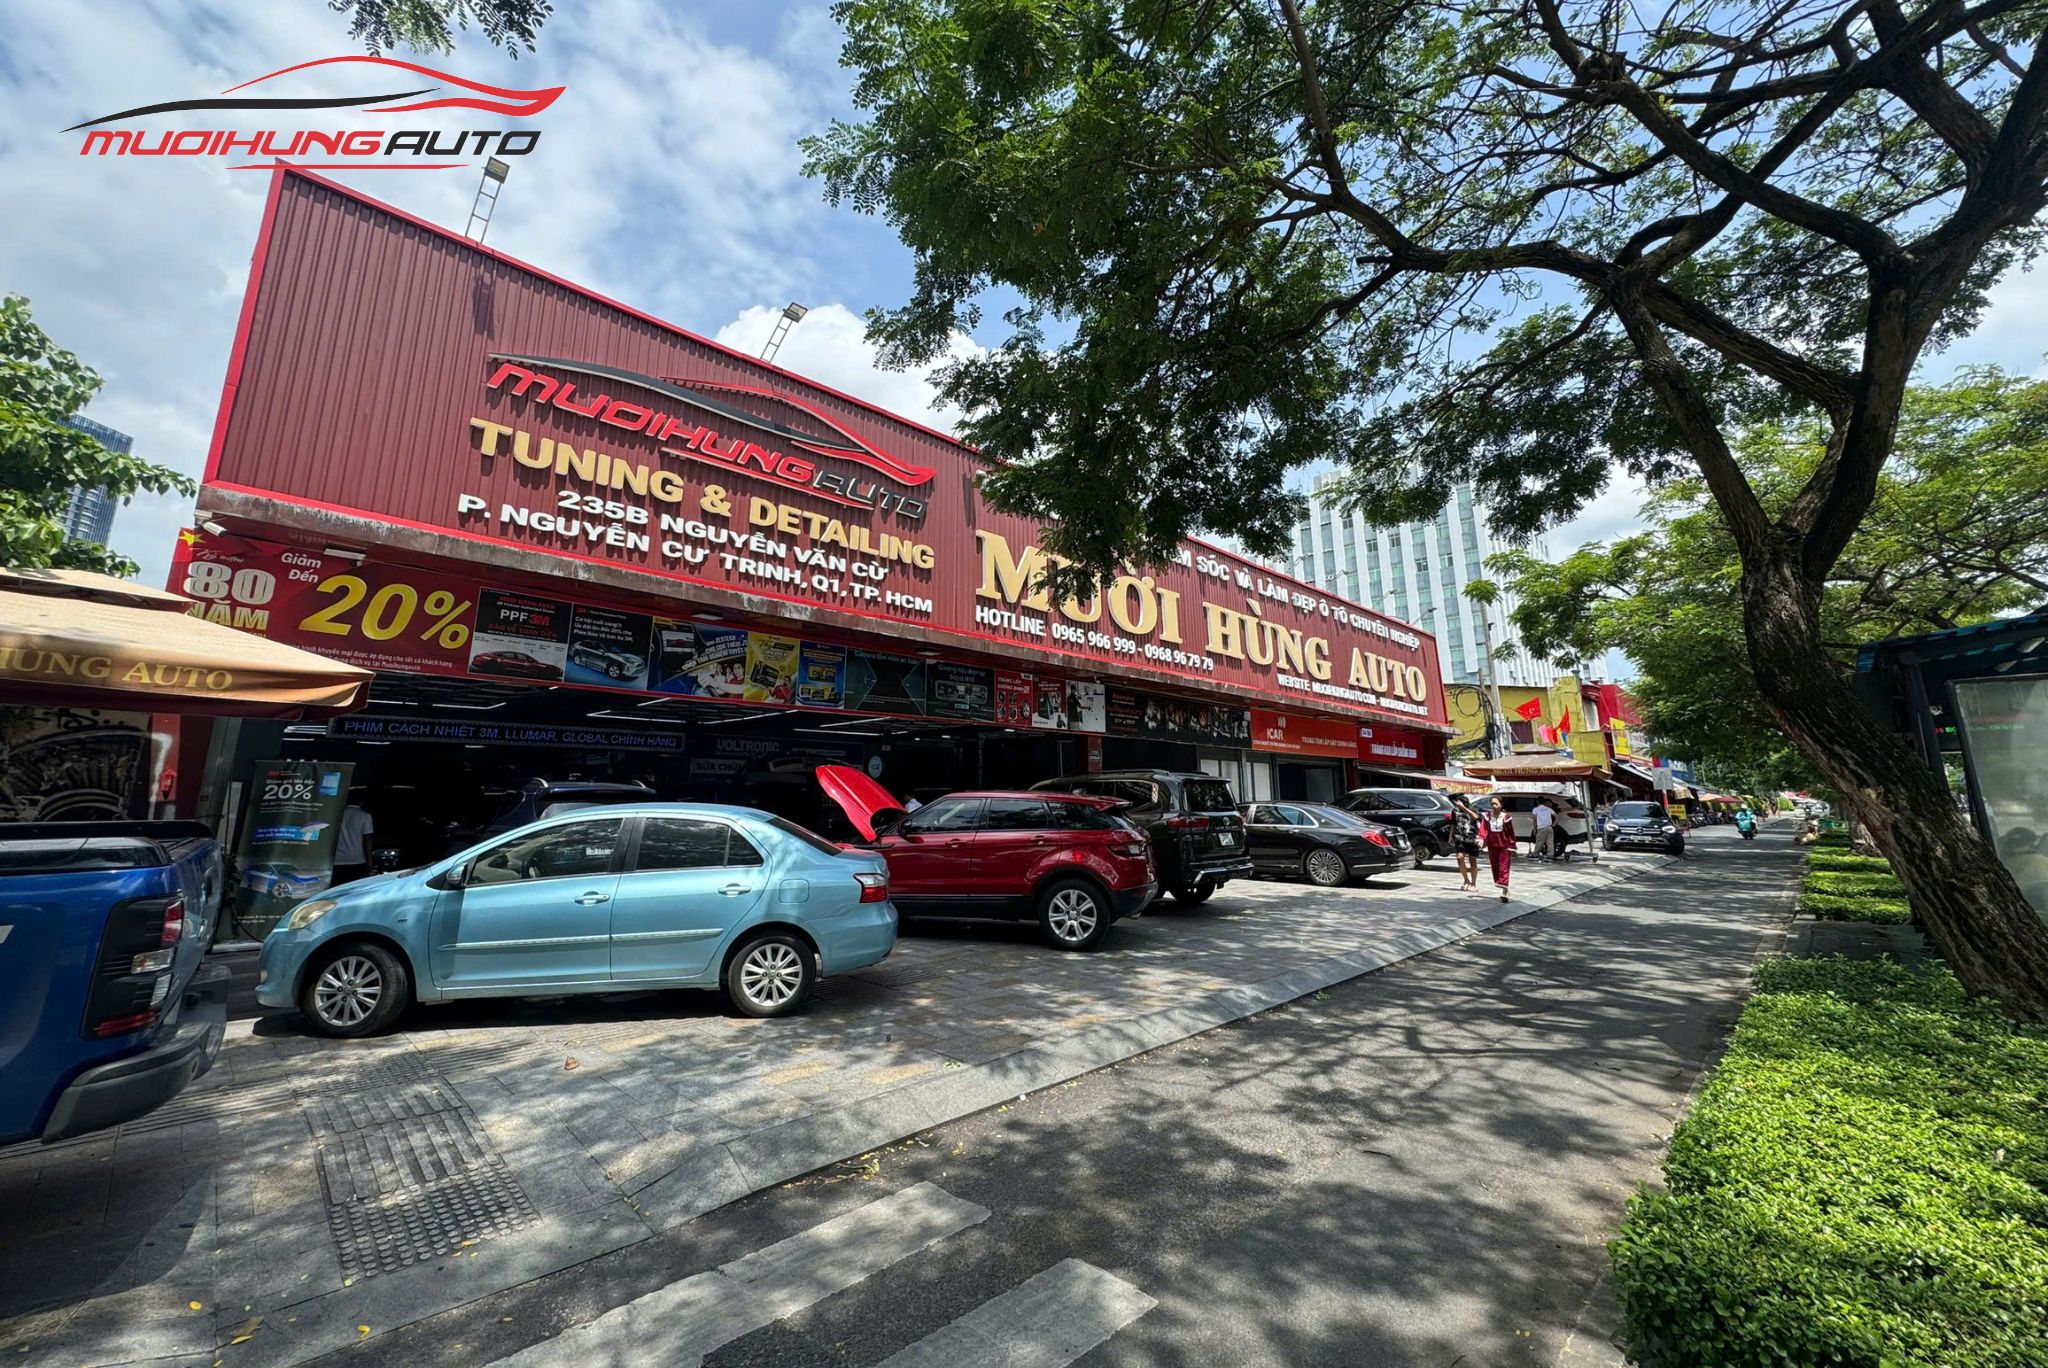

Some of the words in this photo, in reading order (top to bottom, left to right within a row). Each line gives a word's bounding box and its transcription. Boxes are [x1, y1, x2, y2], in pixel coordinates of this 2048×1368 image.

[469, 417, 684, 503] TUNING
[700, 484, 732, 517] &
[749, 499, 935, 569] DETAILING
[457, 493, 491, 519] P.
[500, 504, 650, 552] NGUYỄN
[661, 540, 710, 563] CƯ
[885, 591, 933, 612] HCM
[558, 490, 649, 525] 235B
[660, 513, 786, 559] NGUYỄN
[793, 546, 846, 572] VĂN
[851, 560, 889, 581] CỪ
[281, 552, 321, 568] Giảm
[288, 569, 318, 583] Đến
[183, 561, 276, 605] 80
[299, 574, 472, 650] 20%
[499, 608, 529, 622] PPF
[529, 613, 551, 626] 3M
[1196, 554, 1230, 581] SÓC
[1234, 567, 1254, 591] VÀ
[1257, 578, 1289, 603] LÀM
[1292, 592, 1317, 614] ĐẸP
[1319, 599, 1330, 617] Ô
[1331, 605, 1348, 624] TÔ
[1349, 613, 1389, 639] CHUYÊN
[1390, 627, 1420, 652] NGHIỆP
[1051, 622, 1085, 644] 0965
[1087, 631, 1111, 650] 966
[1113, 636, 1136, 654] 999
[1144, 643, 1173, 661] 0968
[1202, 599, 1333, 680] HÙNG
[1347, 647, 1427, 703] AUTO
[122, 661, 233, 690] AUTO
[1277, 673, 1311, 691] WEBSITE
[344, 720, 383, 733] PHIM
[561, 732, 608, 744] GLOBAL
[717, 737, 780, 752] VOLTRONIC
[263, 784, 314, 800] 20%
